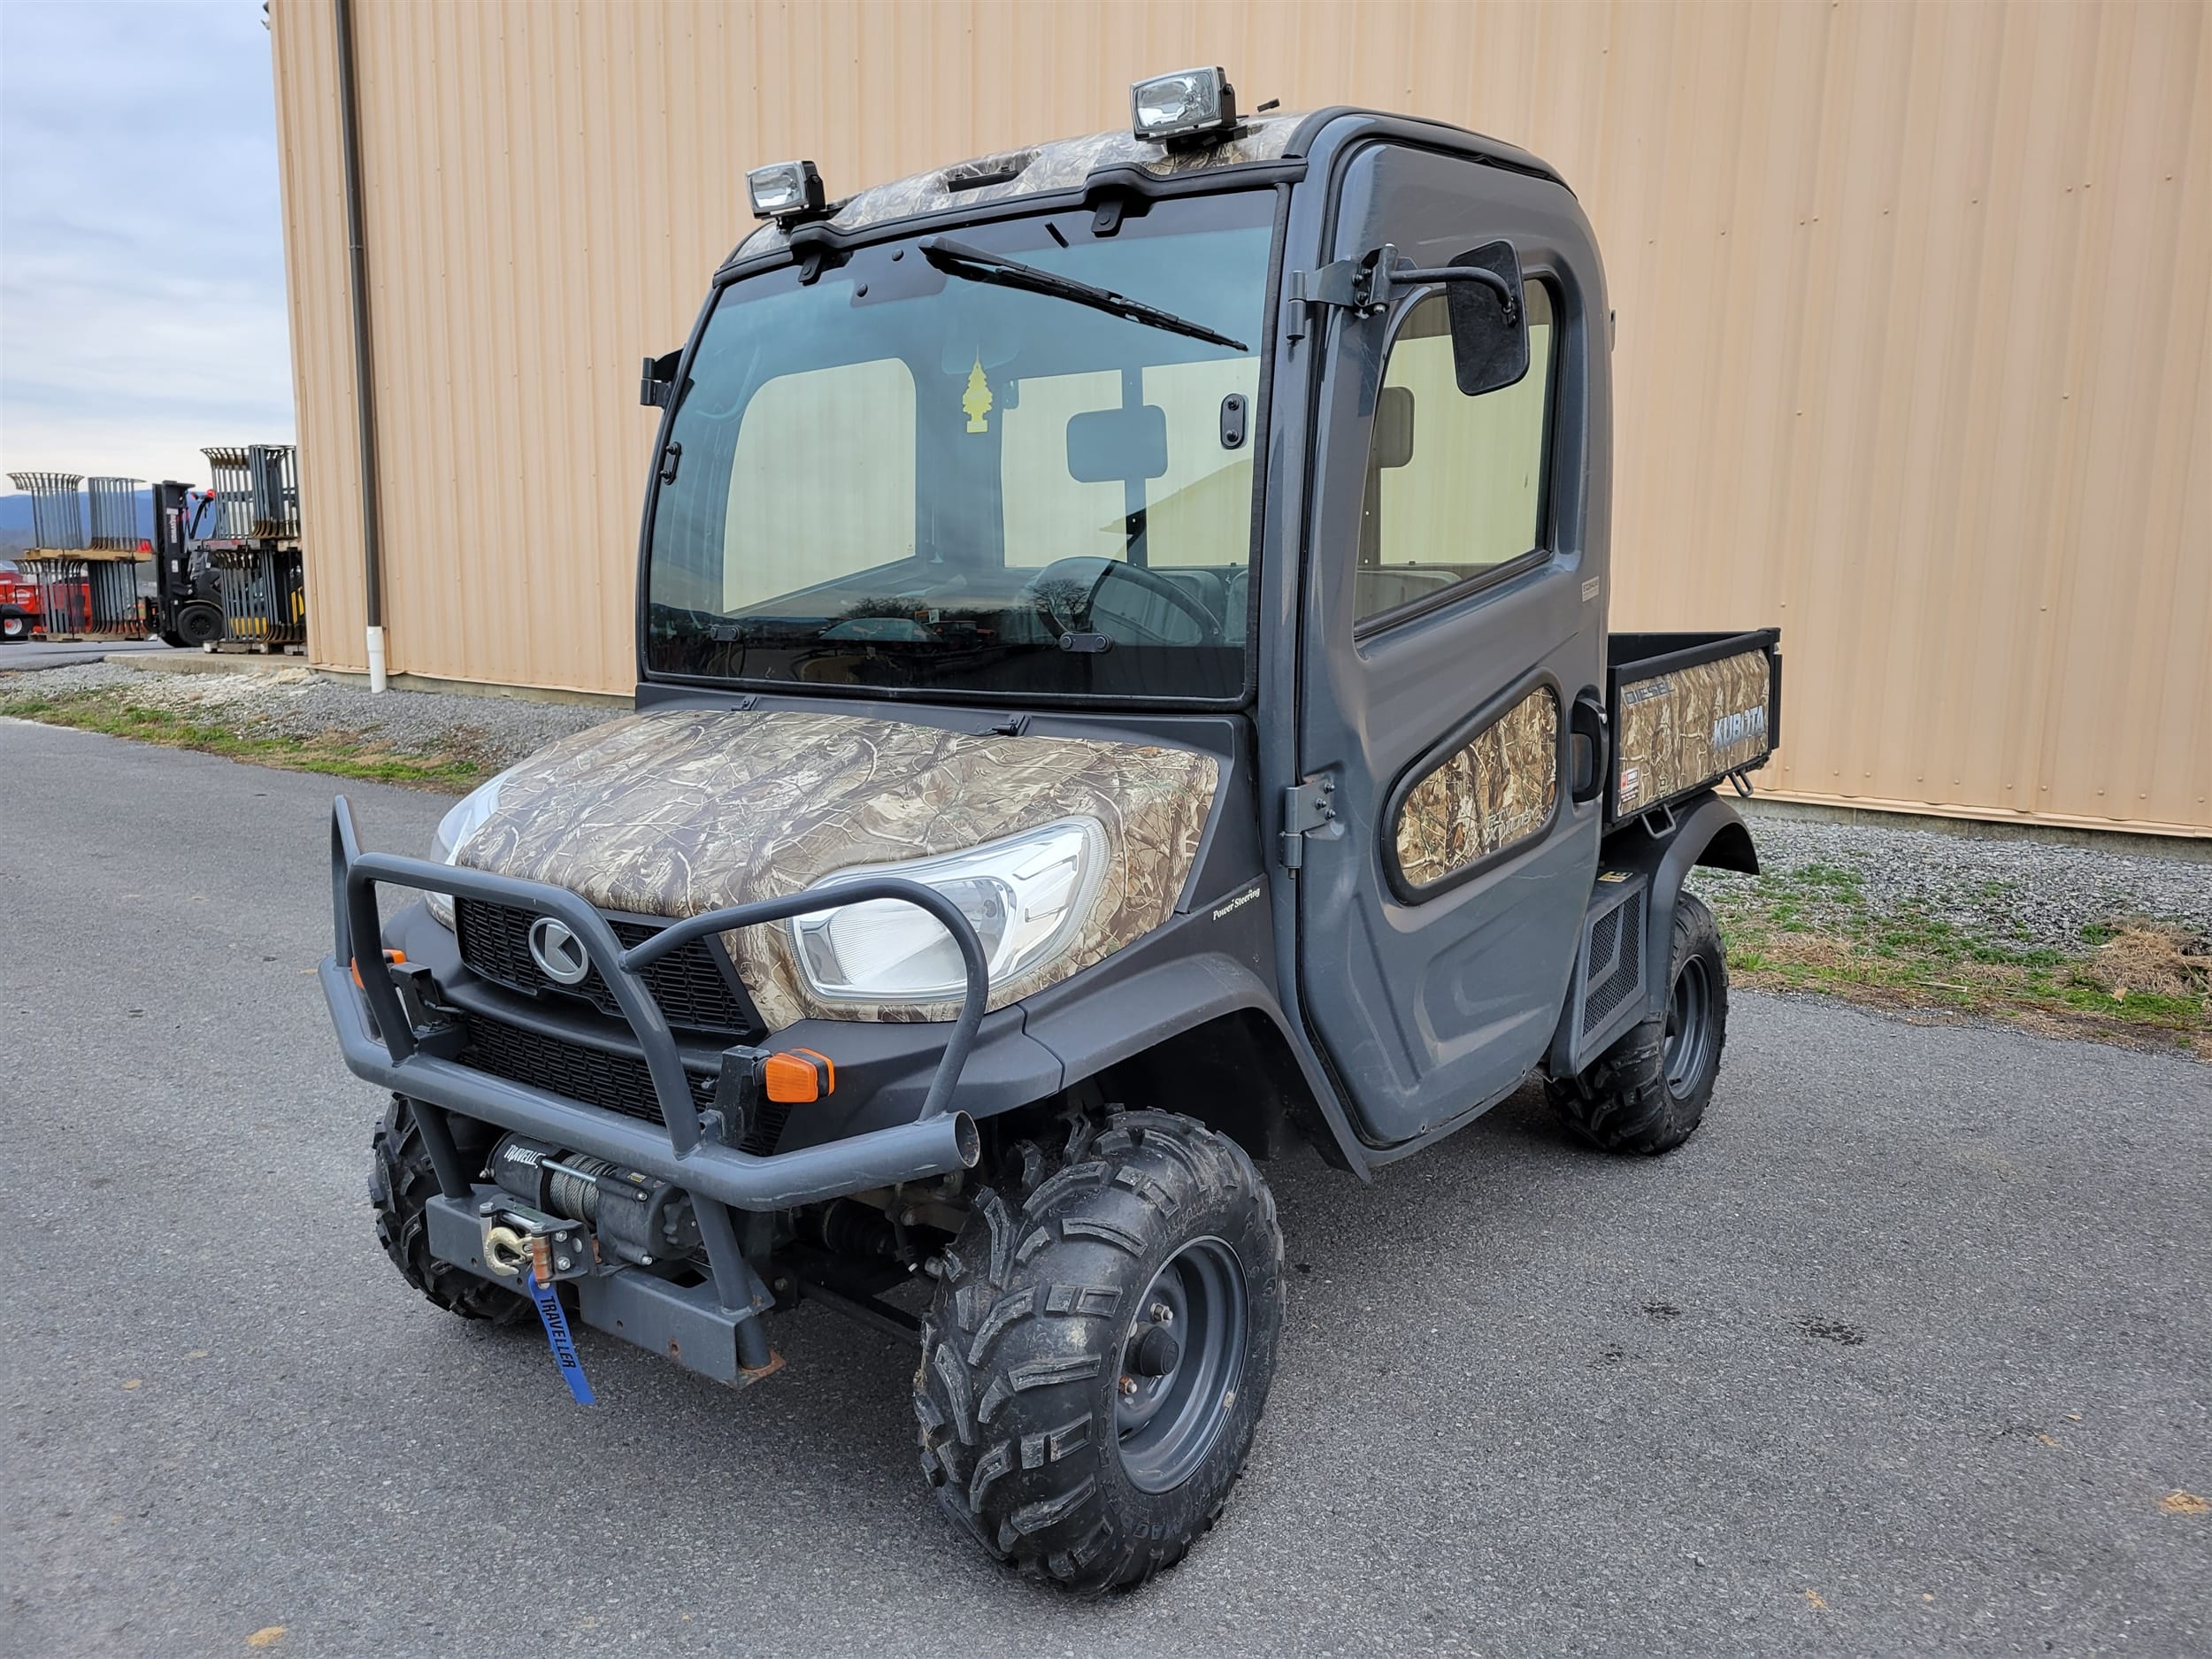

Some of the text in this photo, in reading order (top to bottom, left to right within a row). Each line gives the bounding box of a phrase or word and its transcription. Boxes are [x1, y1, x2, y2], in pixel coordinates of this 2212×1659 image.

[1624, 680, 1676, 705] DIESEL
[1713, 705, 1765, 750] KUBOTA
[1213, 887, 1261, 921] Power Steering
[541, 1295, 577, 1368] TRAVELLER
